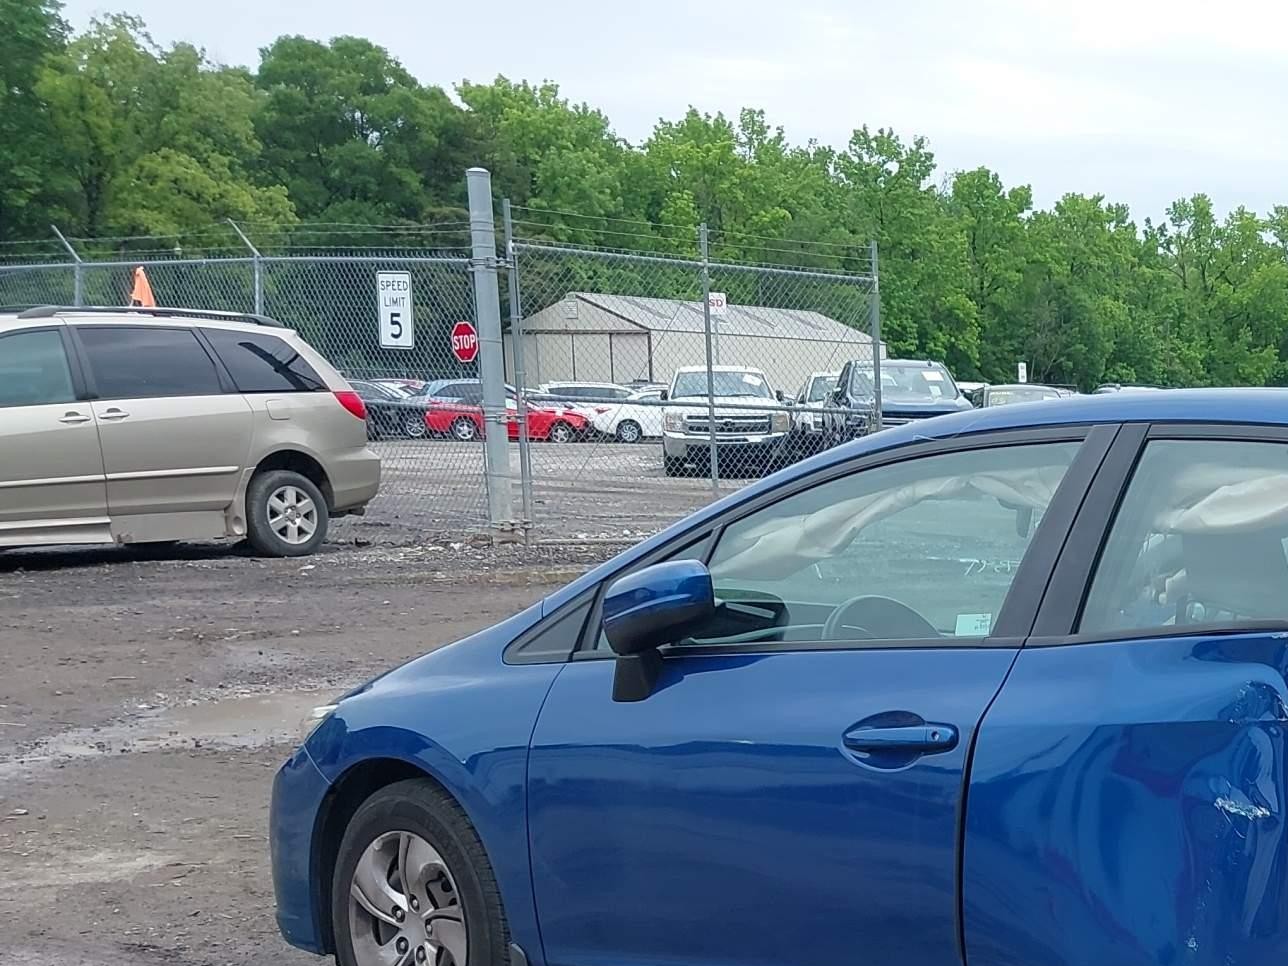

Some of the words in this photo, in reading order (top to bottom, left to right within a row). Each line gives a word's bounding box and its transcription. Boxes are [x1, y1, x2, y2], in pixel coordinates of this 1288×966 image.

[380, 280, 408, 291] SPEED
[384, 297, 405, 307] LIMIT
[390, 312, 402, 339] 5
[453, 334, 476, 350] STOP
